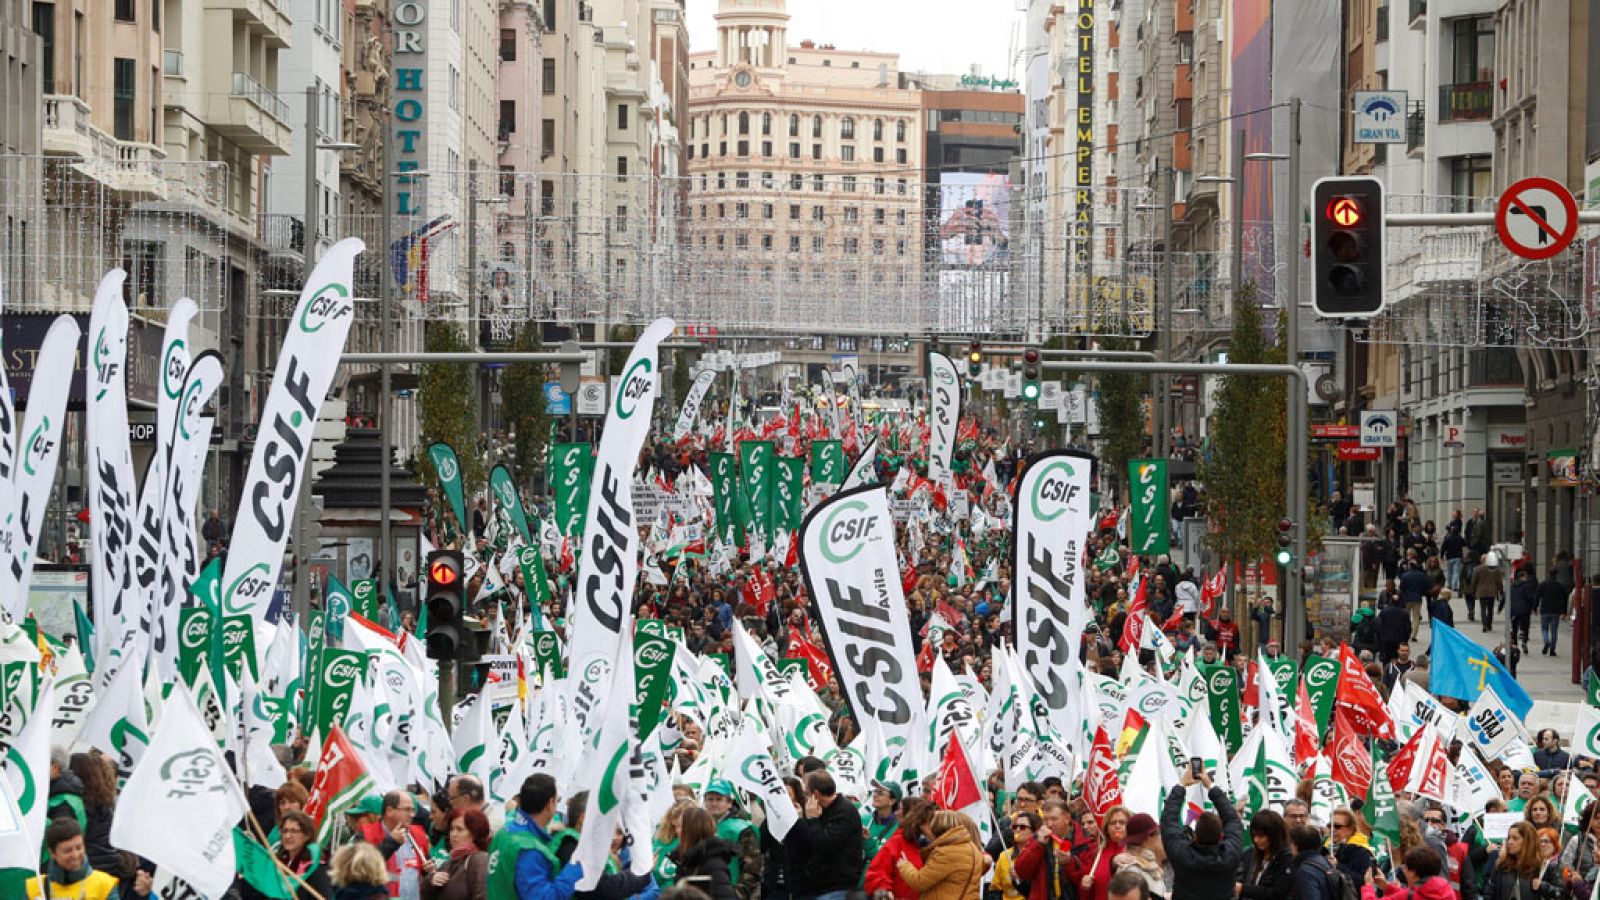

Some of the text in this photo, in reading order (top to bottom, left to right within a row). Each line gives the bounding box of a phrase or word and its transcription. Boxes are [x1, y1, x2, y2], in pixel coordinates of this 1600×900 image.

[394, 68, 424, 215] HOTEL
[1360, 128, 1384, 139] GRAN
[1076, 107, 1092, 264] EMPERADO
[128, 425, 154, 439] HOP
[831, 515, 878, 543] CSIF
[1040, 478, 1080, 503] CSIF
[586, 462, 631, 634] CSIF
[825, 577, 912, 726] CSIF
[1025, 531, 1071, 710] CSIF
[1475, 709, 1504, 739] STAJ
